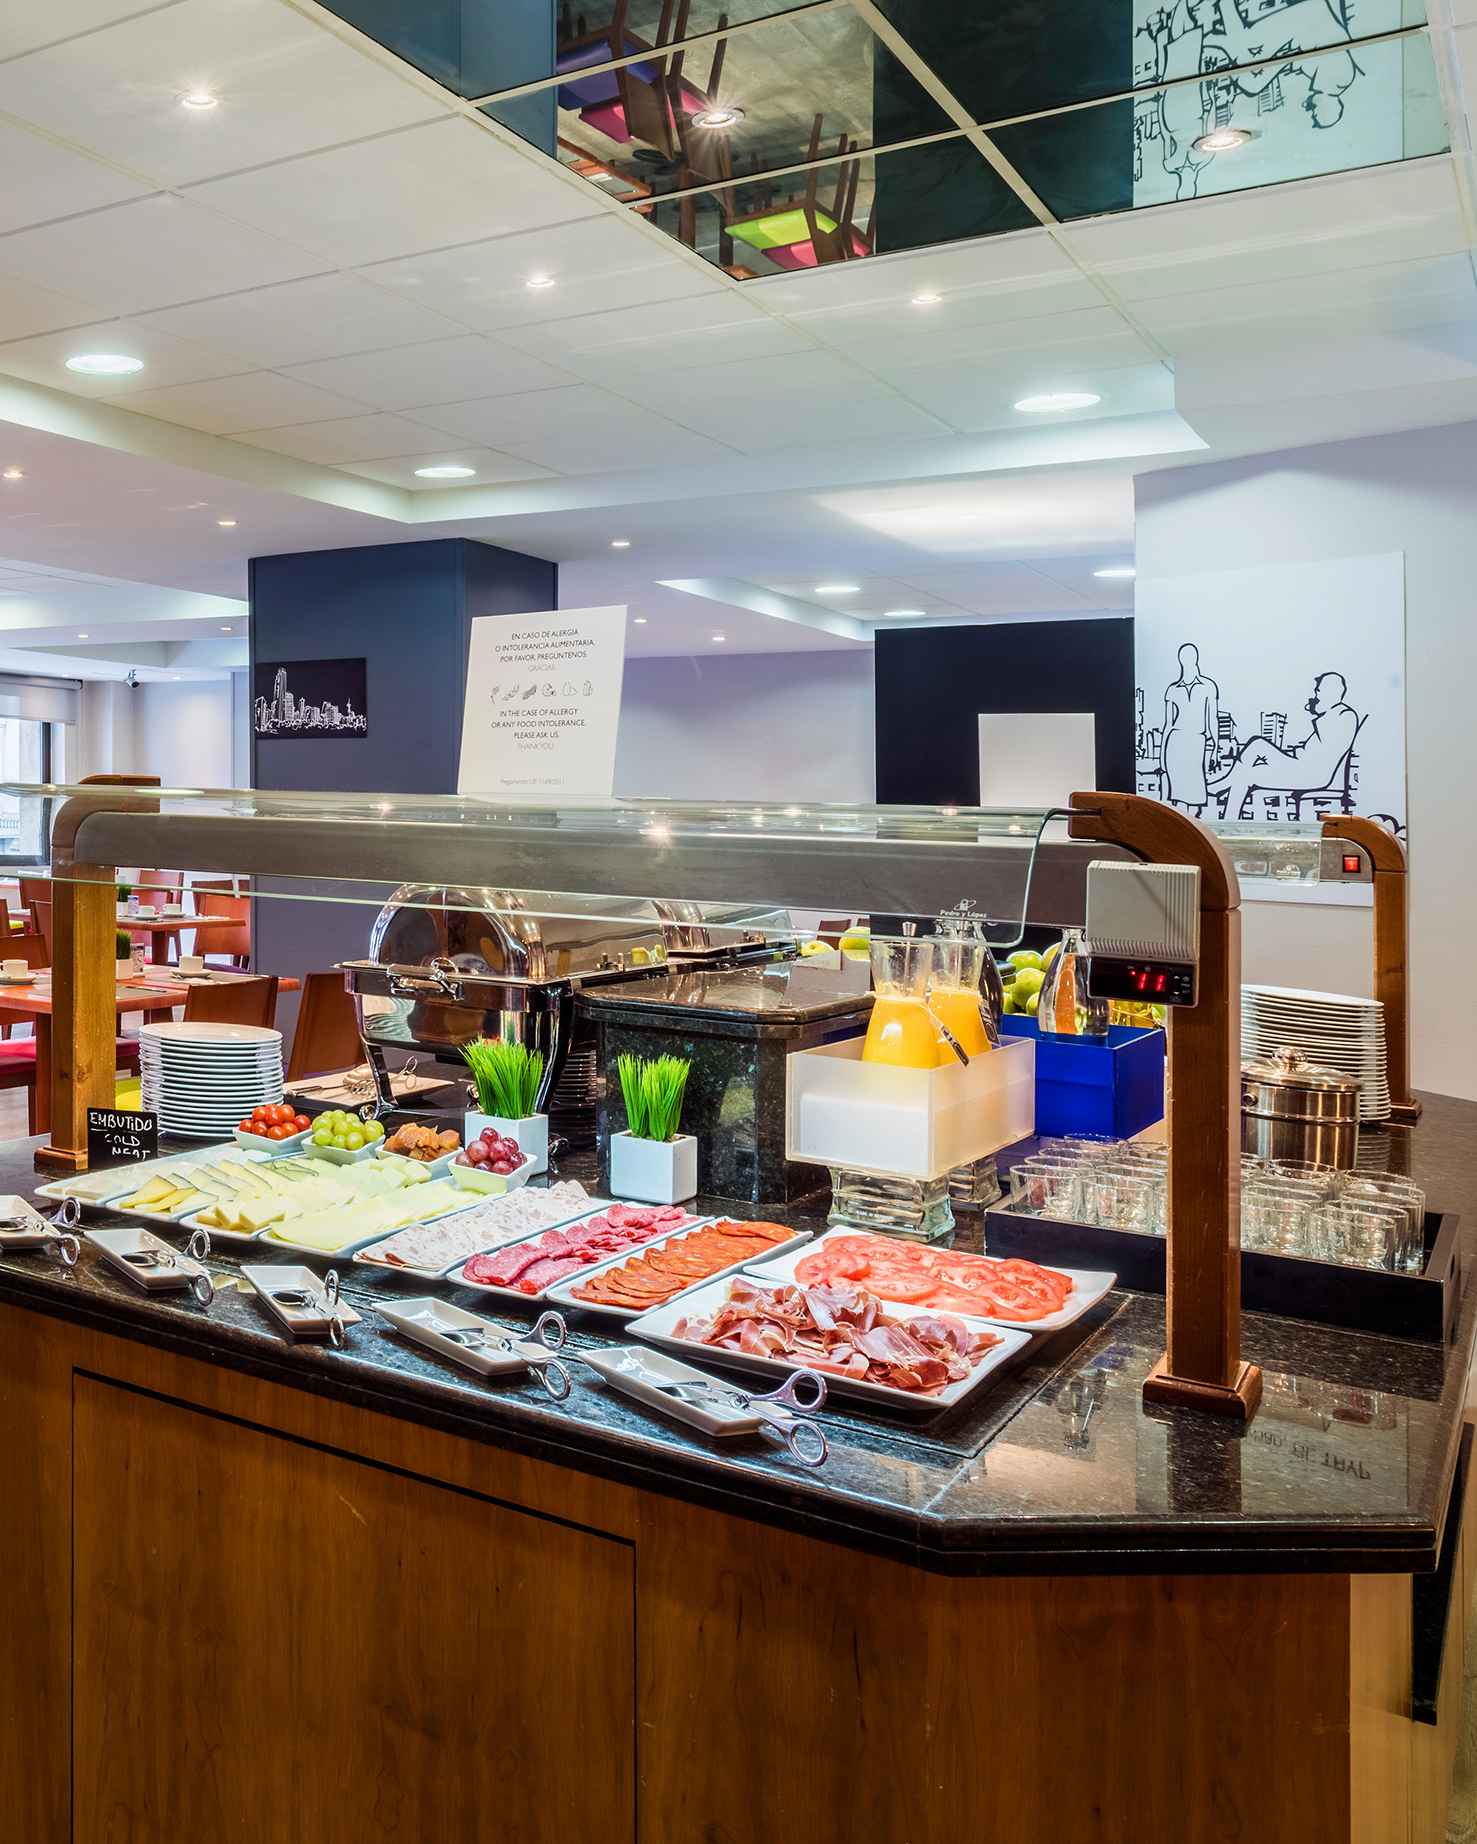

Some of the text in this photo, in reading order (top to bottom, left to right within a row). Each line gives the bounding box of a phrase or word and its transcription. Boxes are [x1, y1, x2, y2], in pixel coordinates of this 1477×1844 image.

[521, 632, 540, 640] CASO
[502, 642, 550, 651] INTOLERANCIA
[105, 1134, 140, 1146] COLD
